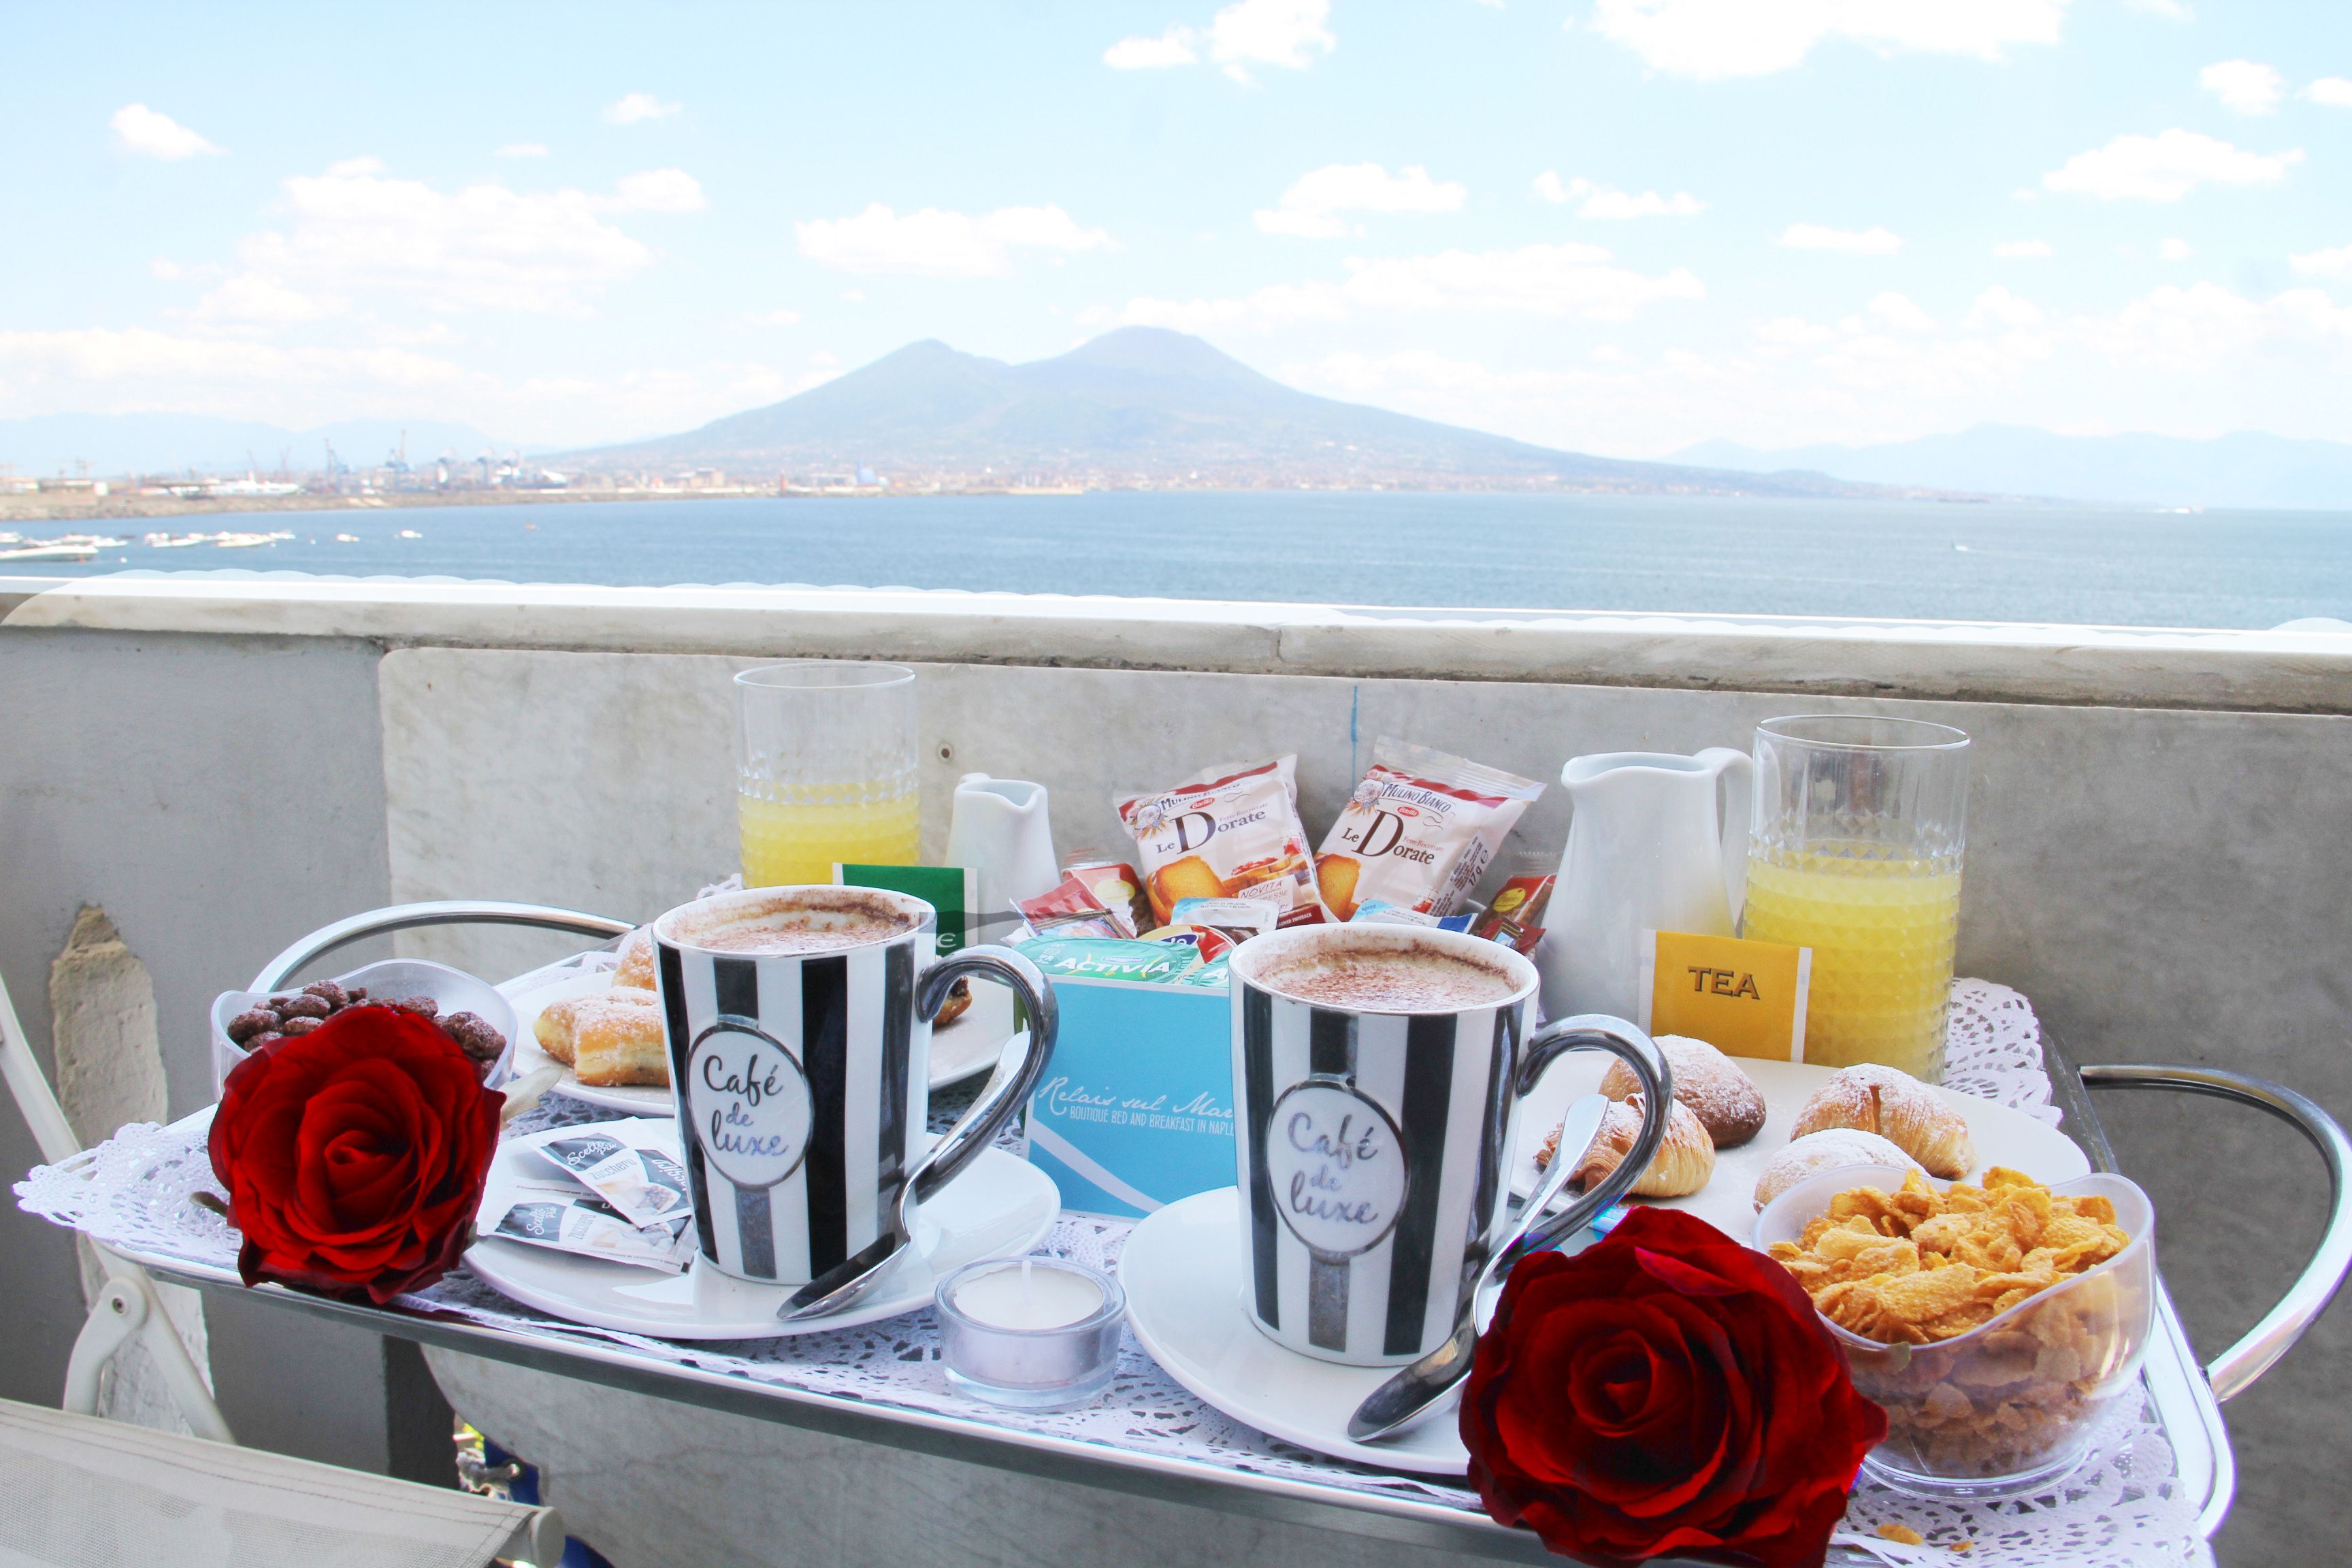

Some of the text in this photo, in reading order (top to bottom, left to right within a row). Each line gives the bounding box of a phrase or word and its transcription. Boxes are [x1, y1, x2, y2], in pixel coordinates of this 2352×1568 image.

[1191, 798, 1213, 809] Barilla
[1382, 783, 1452, 813] MULINO BIANCO
[1156, 841, 1175, 854] Le
[1169, 811, 1267, 855] Dorate
[1341, 828, 1360, 843] Le
[1351, 808, 1435, 865] Dorate
[1056, 958, 1170, 973] ACTIVIA
[1687, 964, 1761, 1000] TEA
[703, 1054, 784, 1107] Café
[725, 1102, 754, 1126] de
[1038, 1077, 1233, 1118] Relais sul Mar
[711, 1109, 789, 1156] luxe
[1070, 1106, 1235, 1137] BOUTIQUE BED AND BREAKFAST IN NAPLE
[567, 1140, 606, 1166] Scelto
[1288, 1112, 1378, 1170] Café
[588, 1158, 638, 1180] zucchero
[1310, 1164, 1343, 1191] de
[1290, 1170, 1379, 1224] luxe
